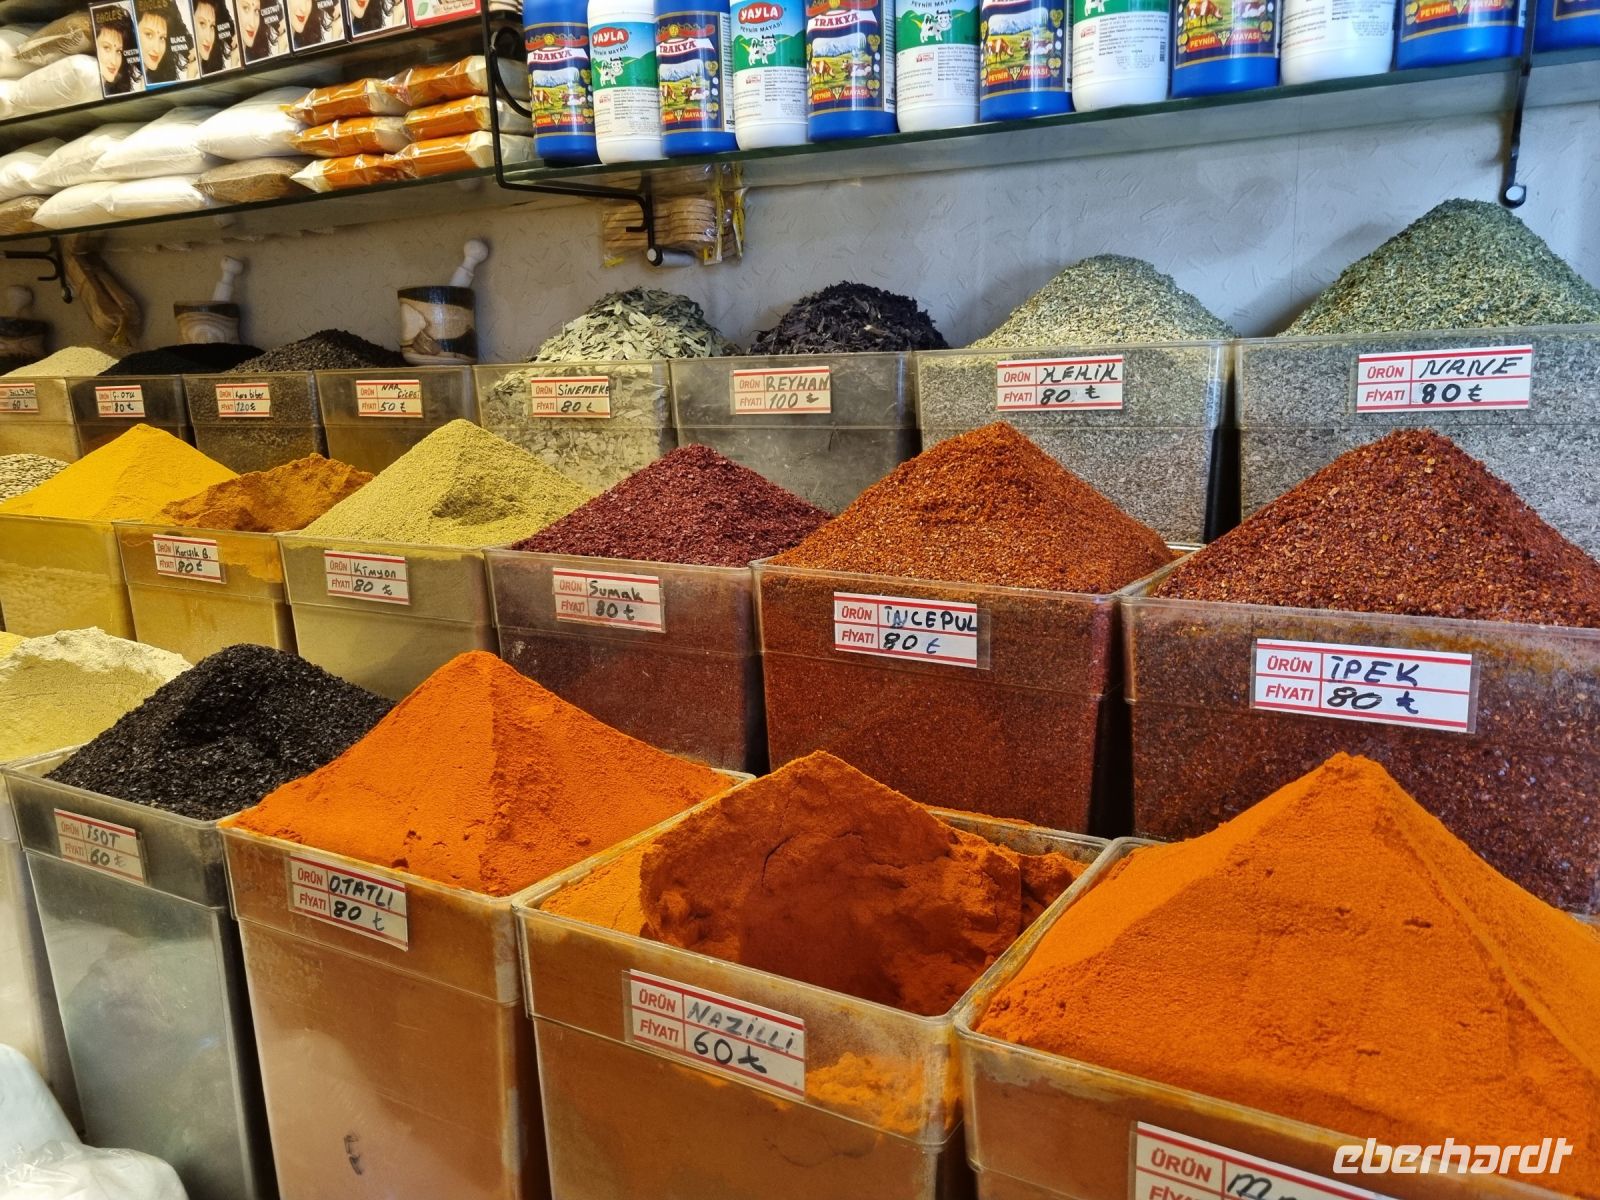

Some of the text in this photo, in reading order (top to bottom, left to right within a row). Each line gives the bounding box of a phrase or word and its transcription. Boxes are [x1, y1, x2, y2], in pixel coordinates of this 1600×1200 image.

[740, 6, 779, 20] YAYLA
[814, 13, 859, 27] TRAKYA
[170, 36, 186, 44] BLACK
[593, 31, 624, 44] YAYLA
[1190, 36, 1216, 48] PEYNİR
[1232, 32, 1260, 40] MAYASI
[659, 41, 697, 53] TRAKYA
[533, 50, 573, 61] TRAKYA
[988, 71, 1009, 82] PEYNİR
[1367, 357, 1523, 379] ÜRÜN NANE
[1003, 371, 1031, 382] ÜRÜN
[535, 386, 553, 395] ÜRÜN
[739, 380, 761, 389] ÜRÜN
[740, 397, 762, 407] FİYATI
[769, 393, 799, 409] 100
[1003, 391, 1032, 402] FİYATI
[1040, 388, 1071, 405] 80
[1365, 389, 1405, 402] FİYATI
[380, 401, 396, 411] 50
[536, 401, 554, 410] FİYATI
[561, 400, 582, 413] 80
[330, 560, 348, 571] ÜRÜN
[331, 578, 350, 588] FİYATI
[354, 578, 374, 592] 80
[560, 580, 643, 601] ÜRÜN Sumak
[561, 599, 585, 611] FİYATI
[595, 600, 619, 618] 80
[841, 605, 873, 620] ÜRÜN
[841, 629, 875, 644] FİYATI
[883, 632, 918, 650] 80
[1267, 656, 1419, 687] ÜRÜN İPEK
[1265, 683, 1314, 701] FİYATI
[1327, 687, 1382, 709] 80
[90, 848, 110, 866] 60
[297, 868, 323, 886] ÜRÜN
[300, 892, 326, 911] FİYATI
[334, 900, 362, 921] 80
[639, 989, 796, 1054] ÜRÜN NAZİLLİ
[640, 1019, 679, 1042] FİYATI
[1151, 1147, 1212, 1183] ÜRÜN
